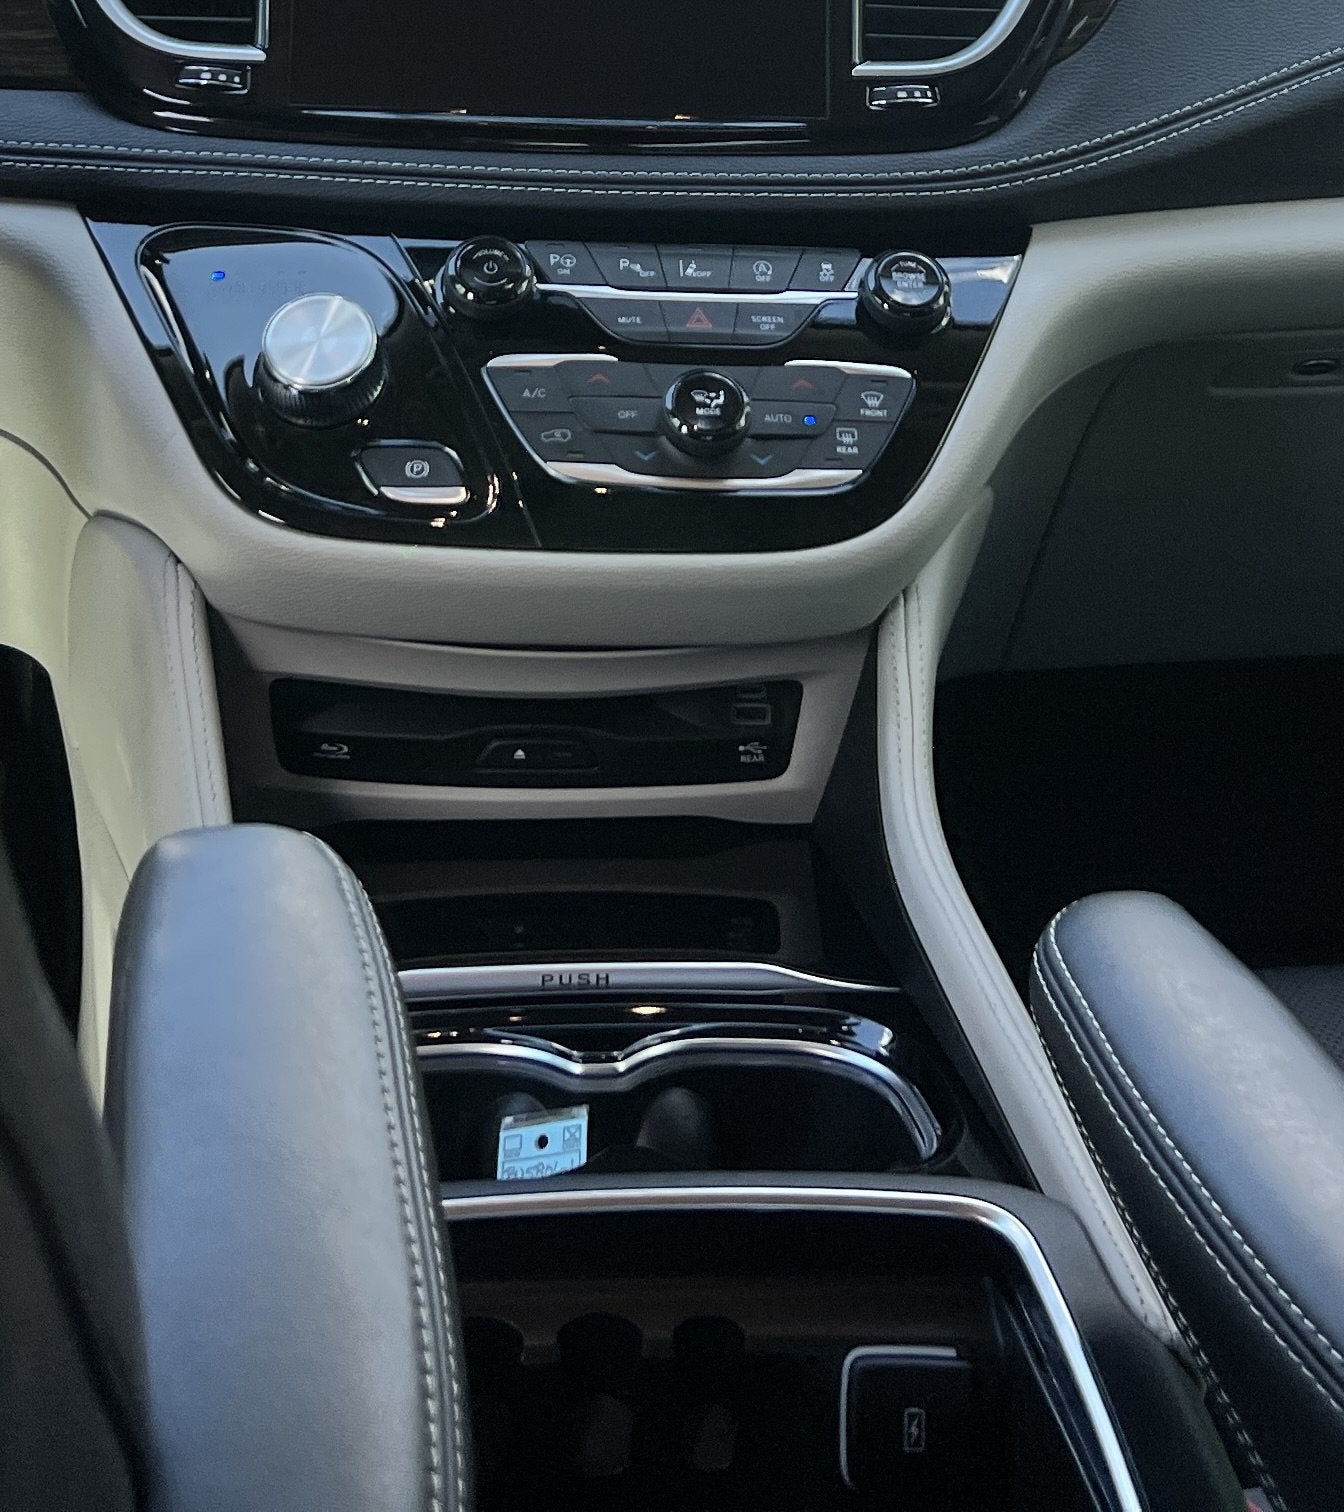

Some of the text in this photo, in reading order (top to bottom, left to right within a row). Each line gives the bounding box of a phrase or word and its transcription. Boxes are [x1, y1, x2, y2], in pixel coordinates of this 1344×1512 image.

[756, 275, 771, 283] OFF
[819, 275, 835, 283] OFF
[897, 280, 924, 289] ENTER
[617, 316, 642, 324] MUTE
[751, 315, 784, 324] SCREEN
[759, 323, 776, 331] OFF
[522, 388, 546, 398] A/C
[617, 409, 638, 420] OFF
[695, 406, 721, 416] MODE
[860, 408, 888, 418] FRONT
[764, 413, 792, 423] AUTO
[836, 445, 858, 454] REAR
[740, 754, 764, 763] REAR
[541, 972, 610, 988] PUSH
